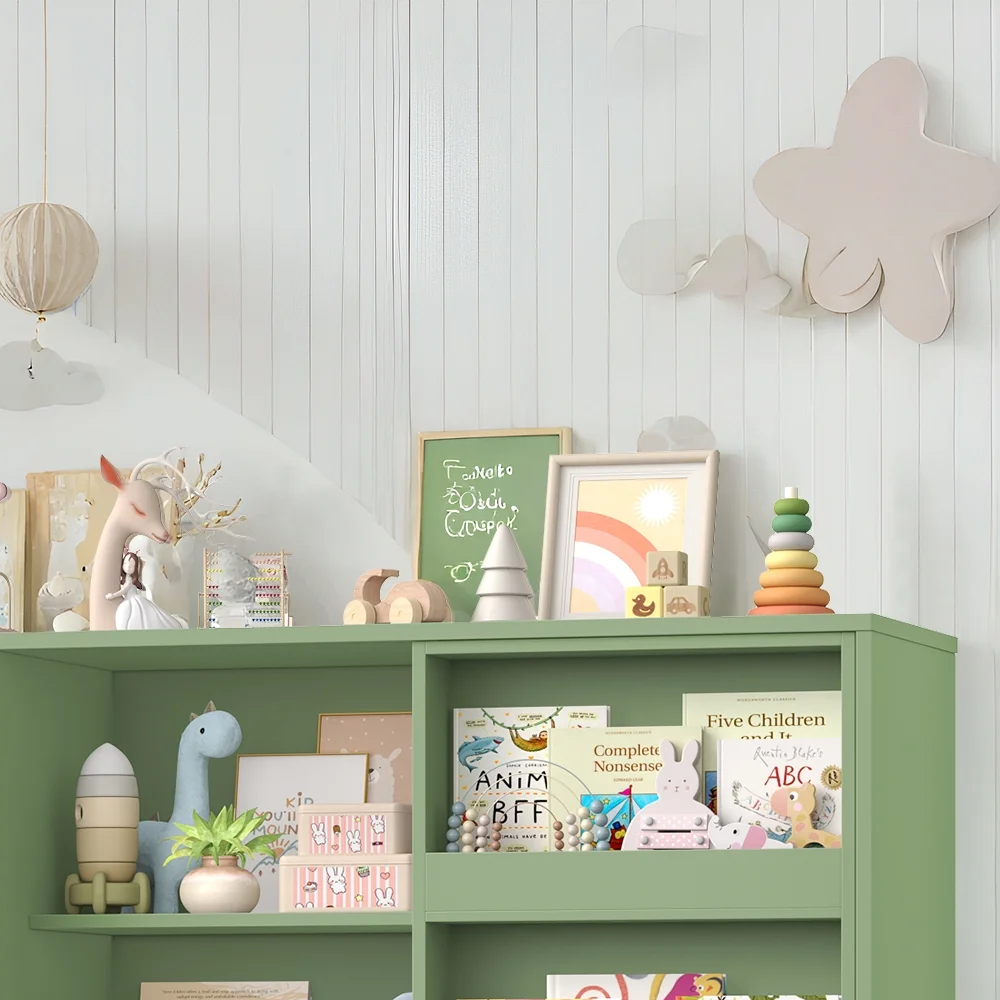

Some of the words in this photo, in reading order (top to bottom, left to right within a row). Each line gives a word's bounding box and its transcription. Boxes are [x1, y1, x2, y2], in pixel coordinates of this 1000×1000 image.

[707, 713, 743, 728] Five
[748, 712, 826, 727] Children
[594, 744, 660, 759] Complete
[594, 760, 663, 773] Nonsense
[764, 765, 812, 787] ABC
[493, 800, 548, 824] BFF
